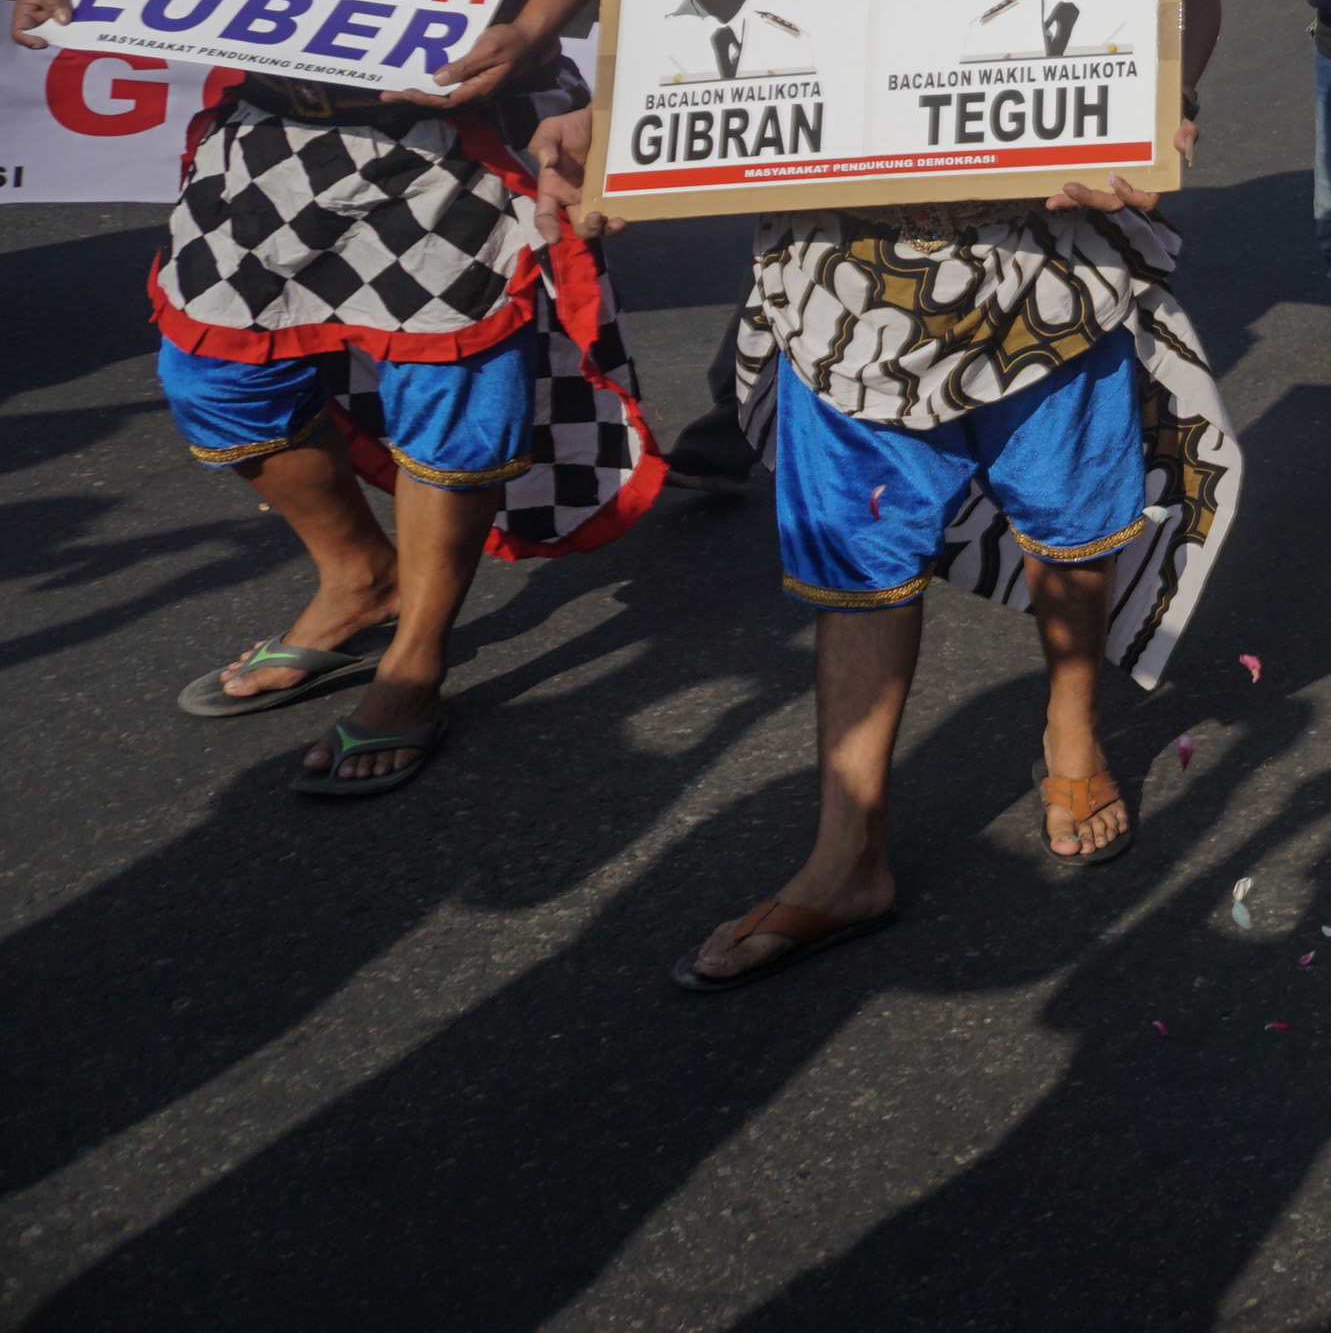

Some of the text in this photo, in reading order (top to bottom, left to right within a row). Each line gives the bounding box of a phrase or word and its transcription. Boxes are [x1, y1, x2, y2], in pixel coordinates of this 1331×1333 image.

[97, 33, 384, 83] MASYARAKAT PENDUKUNG DEMOKRASI
[887, 60, 1138, 91] BACALON WAKIL WALIKOTA
[645, 80, 822, 111] BACALON WALIKOTA
[630, 102, 824, 166] GIBRAN
[919, 85, 1110, 147] TEGUH
[744, 154, 997, 179] MASYARAKAT PENDUKUNG DEMOKRASI
